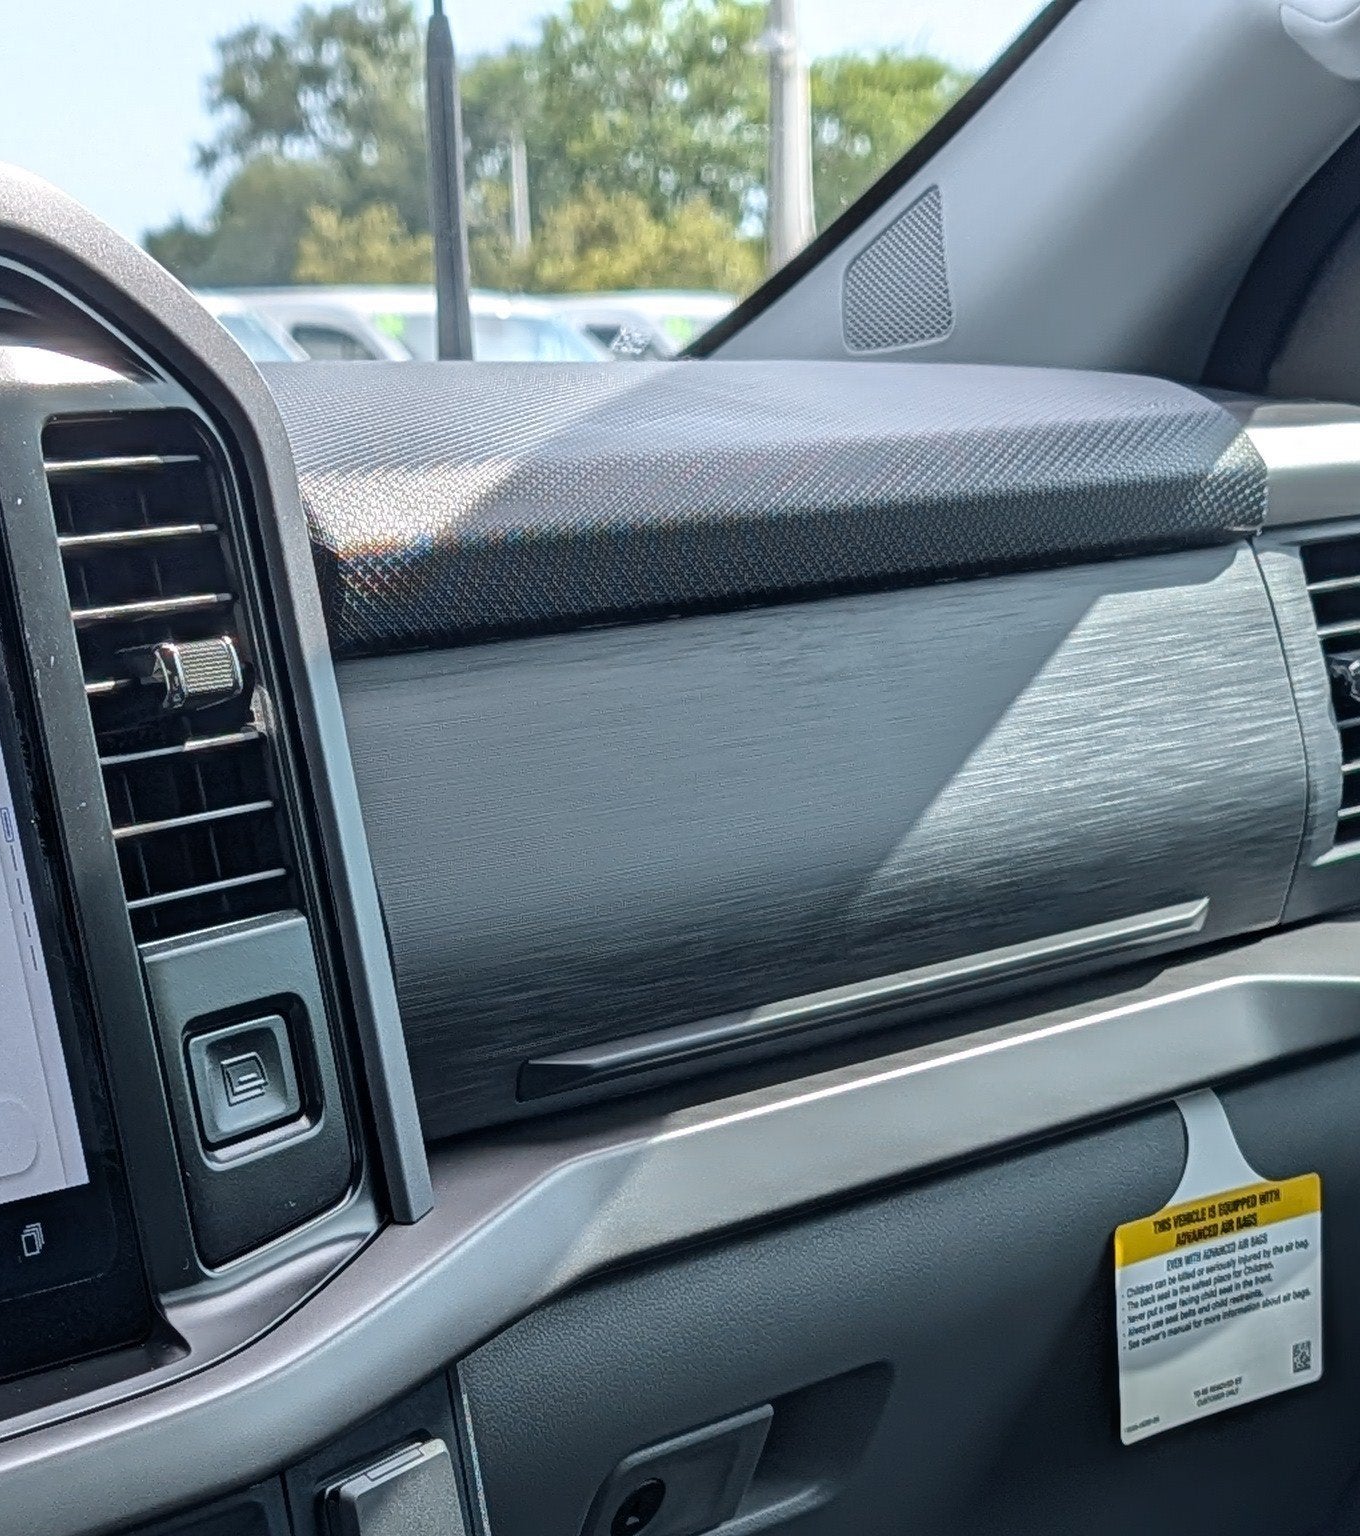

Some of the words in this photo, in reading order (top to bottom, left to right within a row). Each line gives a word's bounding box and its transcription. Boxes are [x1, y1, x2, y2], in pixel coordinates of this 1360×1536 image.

[1153, 1217, 1172, 1234] THIS
[1172, 1209, 1206, 1229] VEHICLE
[1208, 1204, 1216, 1219] IS
[1218, 1194, 1257, 1217] EQUIPPED
[1259, 1188, 1280, 1206] WITH
[1175, 1223, 1219, 1247] ADVANCED
[1220, 1218, 1235, 1235] AIR
[1236, 1212, 1258, 1231] BAGS
[1127, 1283, 1153, 1298] Children
[1154, 1279, 1166, 1290] can
[1168, 1276, 1176, 1286] be
[1177, 1268, 1196, 1282] killed
[1197, 1267, 1205, 1276] or
[1206, 1259, 1236, 1274] seriously
[1238, 1250, 1261, 1265] injured
[1263, 1249, 1271, 1259] by
[1272, 1245, 1283, 1255] the
[1285, 1242, 1294, 1252] air
[1166, 1257, 1183, 1271] EVEN
[1184, 1251, 1202, 1265] WITH
[1202, 1241, 1236, 1260] ADVANCED
[1238, 1238, 1249, 1250] AIR
[1250, 1232, 1268, 1247] BAGS
[1127, 1300, 1139, 1310] The
[1140, 1294, 1156, 1307] back
[1157, 1290, 1171, 1302] seat
[1172, 1288, 1178, 1297] is
[1179, 1285, 1190, 1294] the
[1213, 1273, 1232, 1286] place
[1233, 1269, 1242, 1278] for
[1127, 1312, 1145, 1324] Never
[1147, 1306, 1158, 1320] put
[1201, 1288, 1217, 1301] child
[1219, 1284, 1233, 1296] seat
[1234, 1282, 1241, 1291] in
[1242, 1279, 1253, 1289] the
[1128, 1323, 1150, 1336] Always
[1151, 1320, 1164, 1330] use
[1165, 1313, 1179, 1325] seat
[1180, 1308, 1196, 1321] belts
[1197, 1303, 1211, 1314] and
[1211, 1298, 1228, 1310] child
[1128, 1339, 1140, 1351] See
[1167, 1322, 1192, 1337] manual
[1192, 1319, 1203, 1329] for
[1203, 1313, 1221, 1326] more
[1222, 1302, 1261, 1320] information
[1262, 1294, 1281, 1308] about
[1282, 1293, 1291, 1303] air
